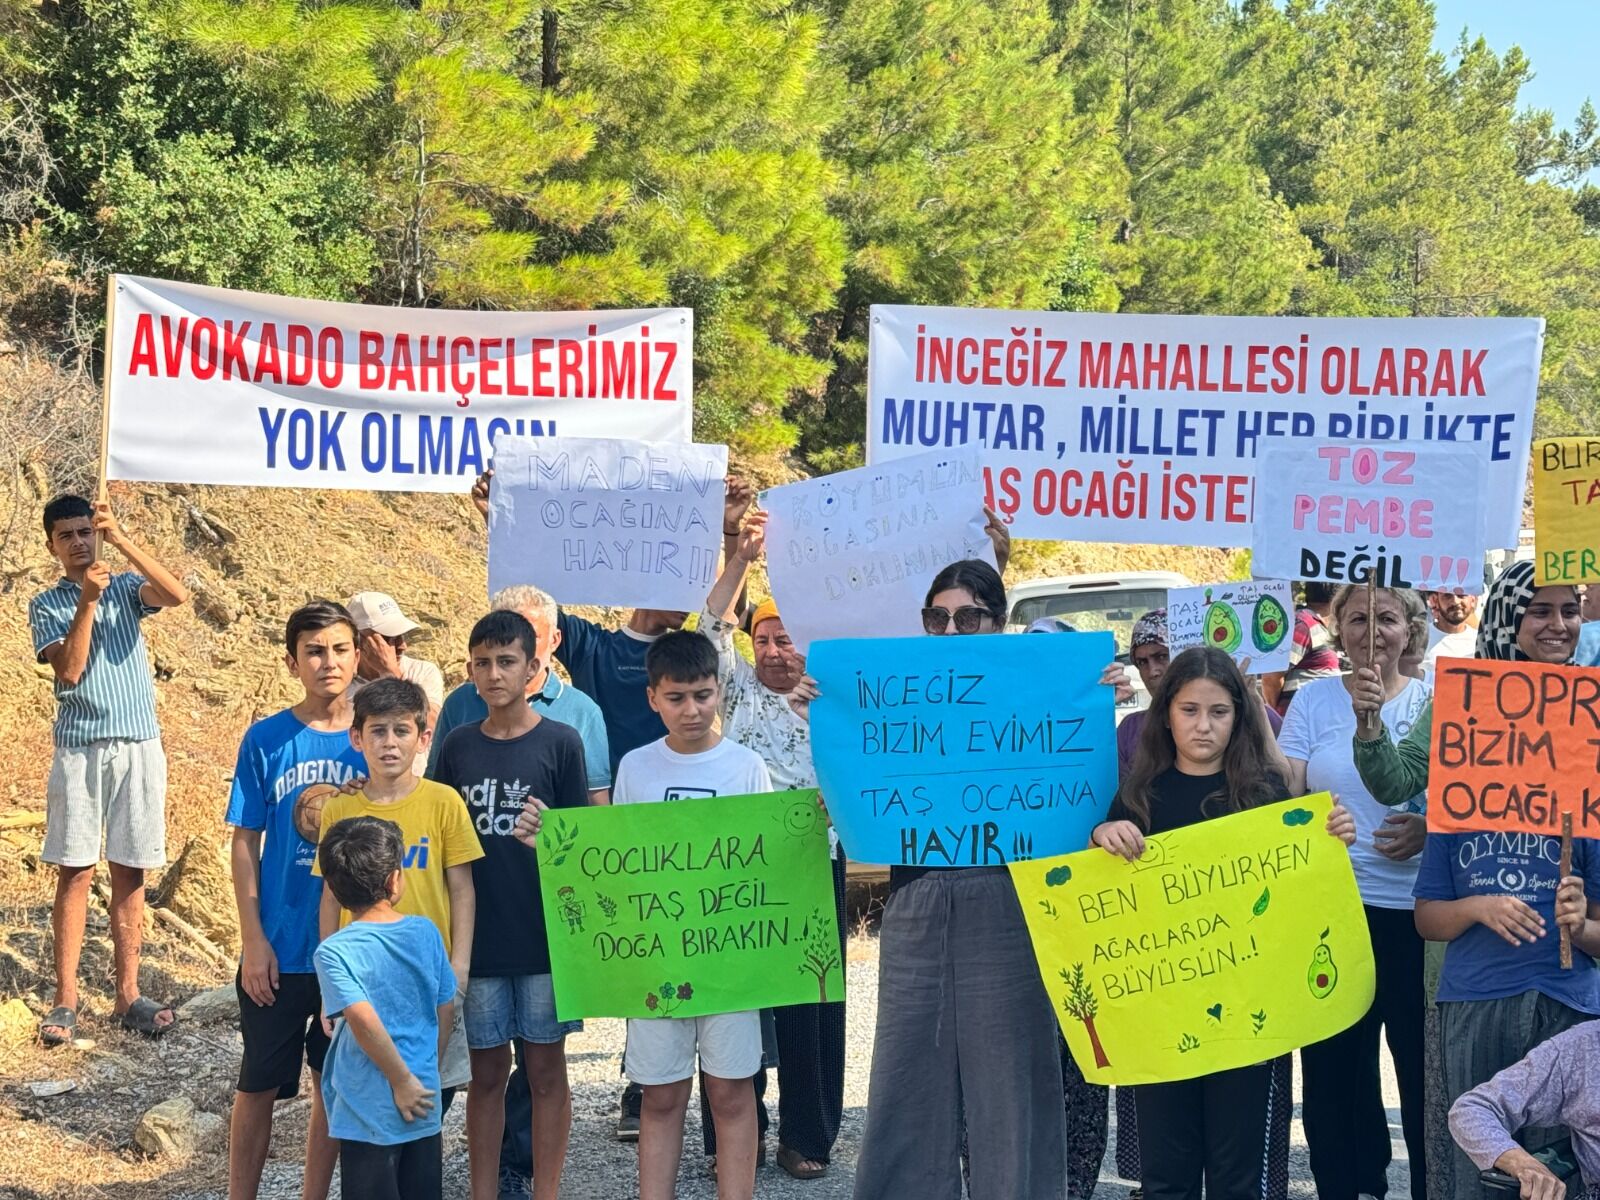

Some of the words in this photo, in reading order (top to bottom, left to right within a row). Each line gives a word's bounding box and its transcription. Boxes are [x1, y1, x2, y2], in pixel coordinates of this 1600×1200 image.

[128, 313, 344, 389] AVOKADO
[358, 324, 678, 407] BAHÇELERİMİZ
[915, 324, 1068, 388] İNCEĞİZ
[1078, 334, 1309, 394] MAHALLESİ
[1320, 346, 1490, 397] OLARAK
[257, 406, 347, 472] YOK
[882, 397, 1046, 451] MUHTAR
[1080, 394, 1226, 457] MİLLET
[528, 451, 713, 498] MADEN
[1318, 446, 1416, 486] TOZ
[1032, 459, 1149, 519] OCAĞI
[1160, 460, 1256, 523] İSTE
[541, 498, 710, 533] OCAĞINA
[1293, 494, 1435, 539] PEMBE
[1300, 544, 1413, 589] DEĞİL
[1170, 601, 1199, 617] TAŞ
[855, 668, 987, 710] İNCEĞİZ
[862, 714, 947, 757] BİZİM
[966, 712, 1095, 755] EVİMİZ
[1438, 715, 1557, 772] BİZİM
[275, 759, 366, 804] ORIGINA
[860, 786, 934, 818] TAŞ
[961, 776, 1098, 813] OCAĞINA
[1441, 782, 1558, 828] OCAĞI
[580, 833, 769, 881] ÇOCUKLARA
[627, 890, 686, 922] TAŞ
[698, 877, 790, 918] DEĞİL
[1077, 883, 1139, 925] BEN
[1161, 838, 1311, 905] BÜYÜRKEN
[1527, 873, 1558, 892] Sport
[592, 931, 666, 962] DOĞA
[1092, 913, 1231, 966] AĞAÇLARDA
